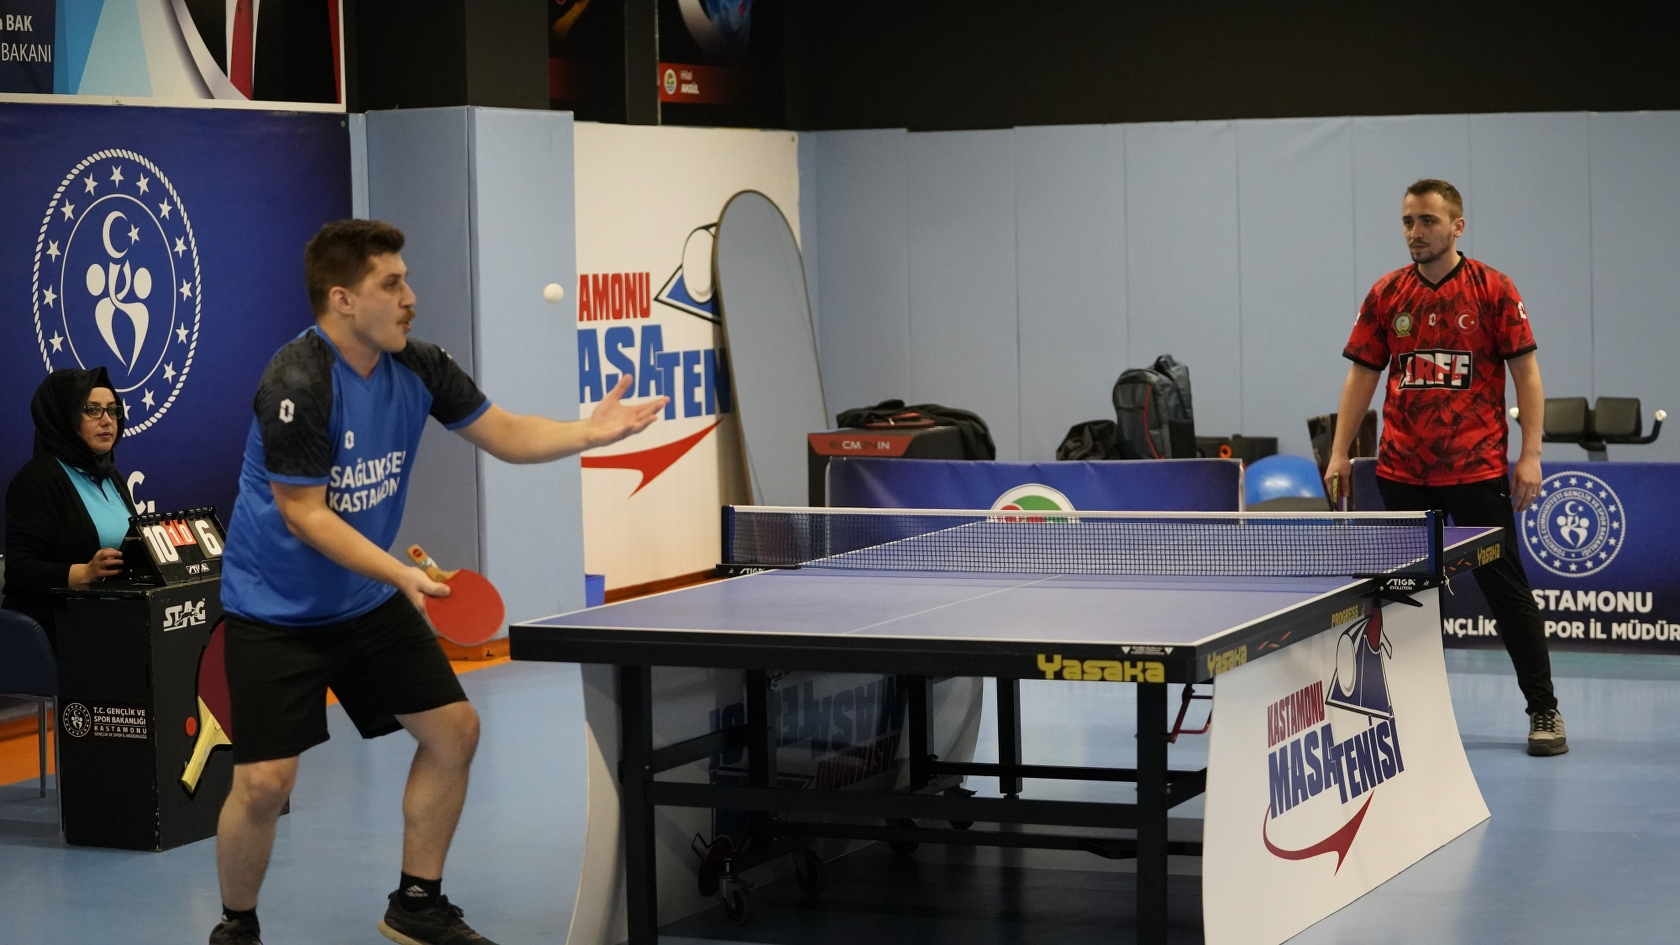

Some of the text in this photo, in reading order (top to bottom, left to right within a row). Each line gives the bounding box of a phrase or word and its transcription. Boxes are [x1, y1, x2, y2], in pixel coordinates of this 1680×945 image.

[6, 14, 33, 32] BAK
[1, 42, 52, 63] BAKANI
[578, 272, 651, 322] AMONU
[842, 440, 862, 450] CM
[877, 440, 891, 450] IN
[142, 525, 179, 563] 10
[194, 520, 223, 556] 6
[1386, 578, 1416, 586] STIGA
[163, 600, 206, 632] STAG
[1331, 604, 1359, 628] PROGRESS
[1589, 618, 1607, 639] İL
[93, 706, 146, 717] T.C. GENÇLİK VE
[93, 715, 146, 725] SPOR BAKANLIĞI
[1267, 680, 1325, 748] KASTAMONU
[94, 726, 147, 734] KASTAMONU
